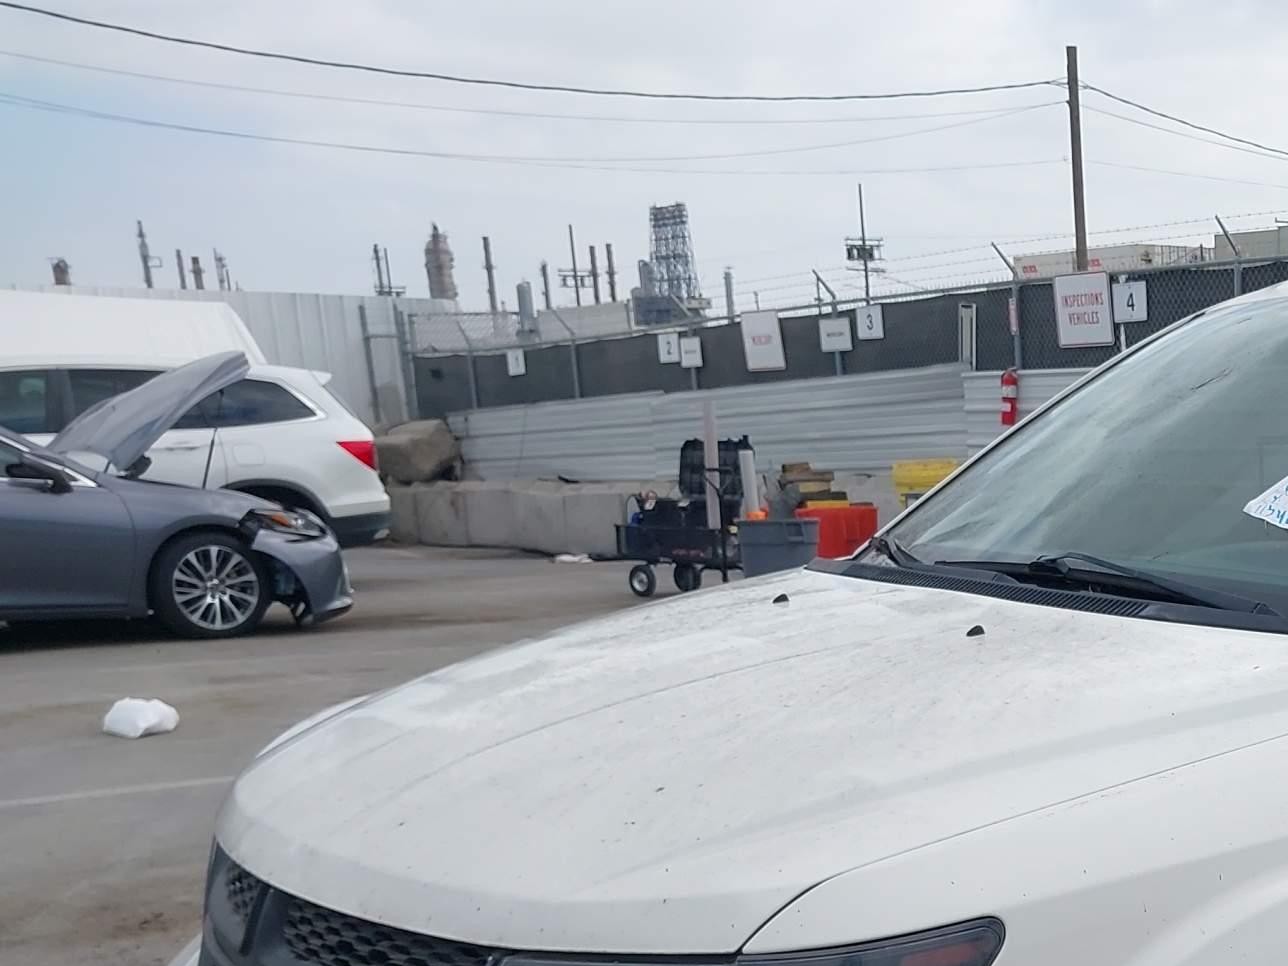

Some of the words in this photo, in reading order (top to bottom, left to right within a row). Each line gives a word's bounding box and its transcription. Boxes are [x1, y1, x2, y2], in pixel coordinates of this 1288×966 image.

[1126, 292, 1136, 312] 4
[864, 313, 874, 331] 3
[1068, 311, 1100, 326] VEHICLES
[666, 340, 673, 355] 2
